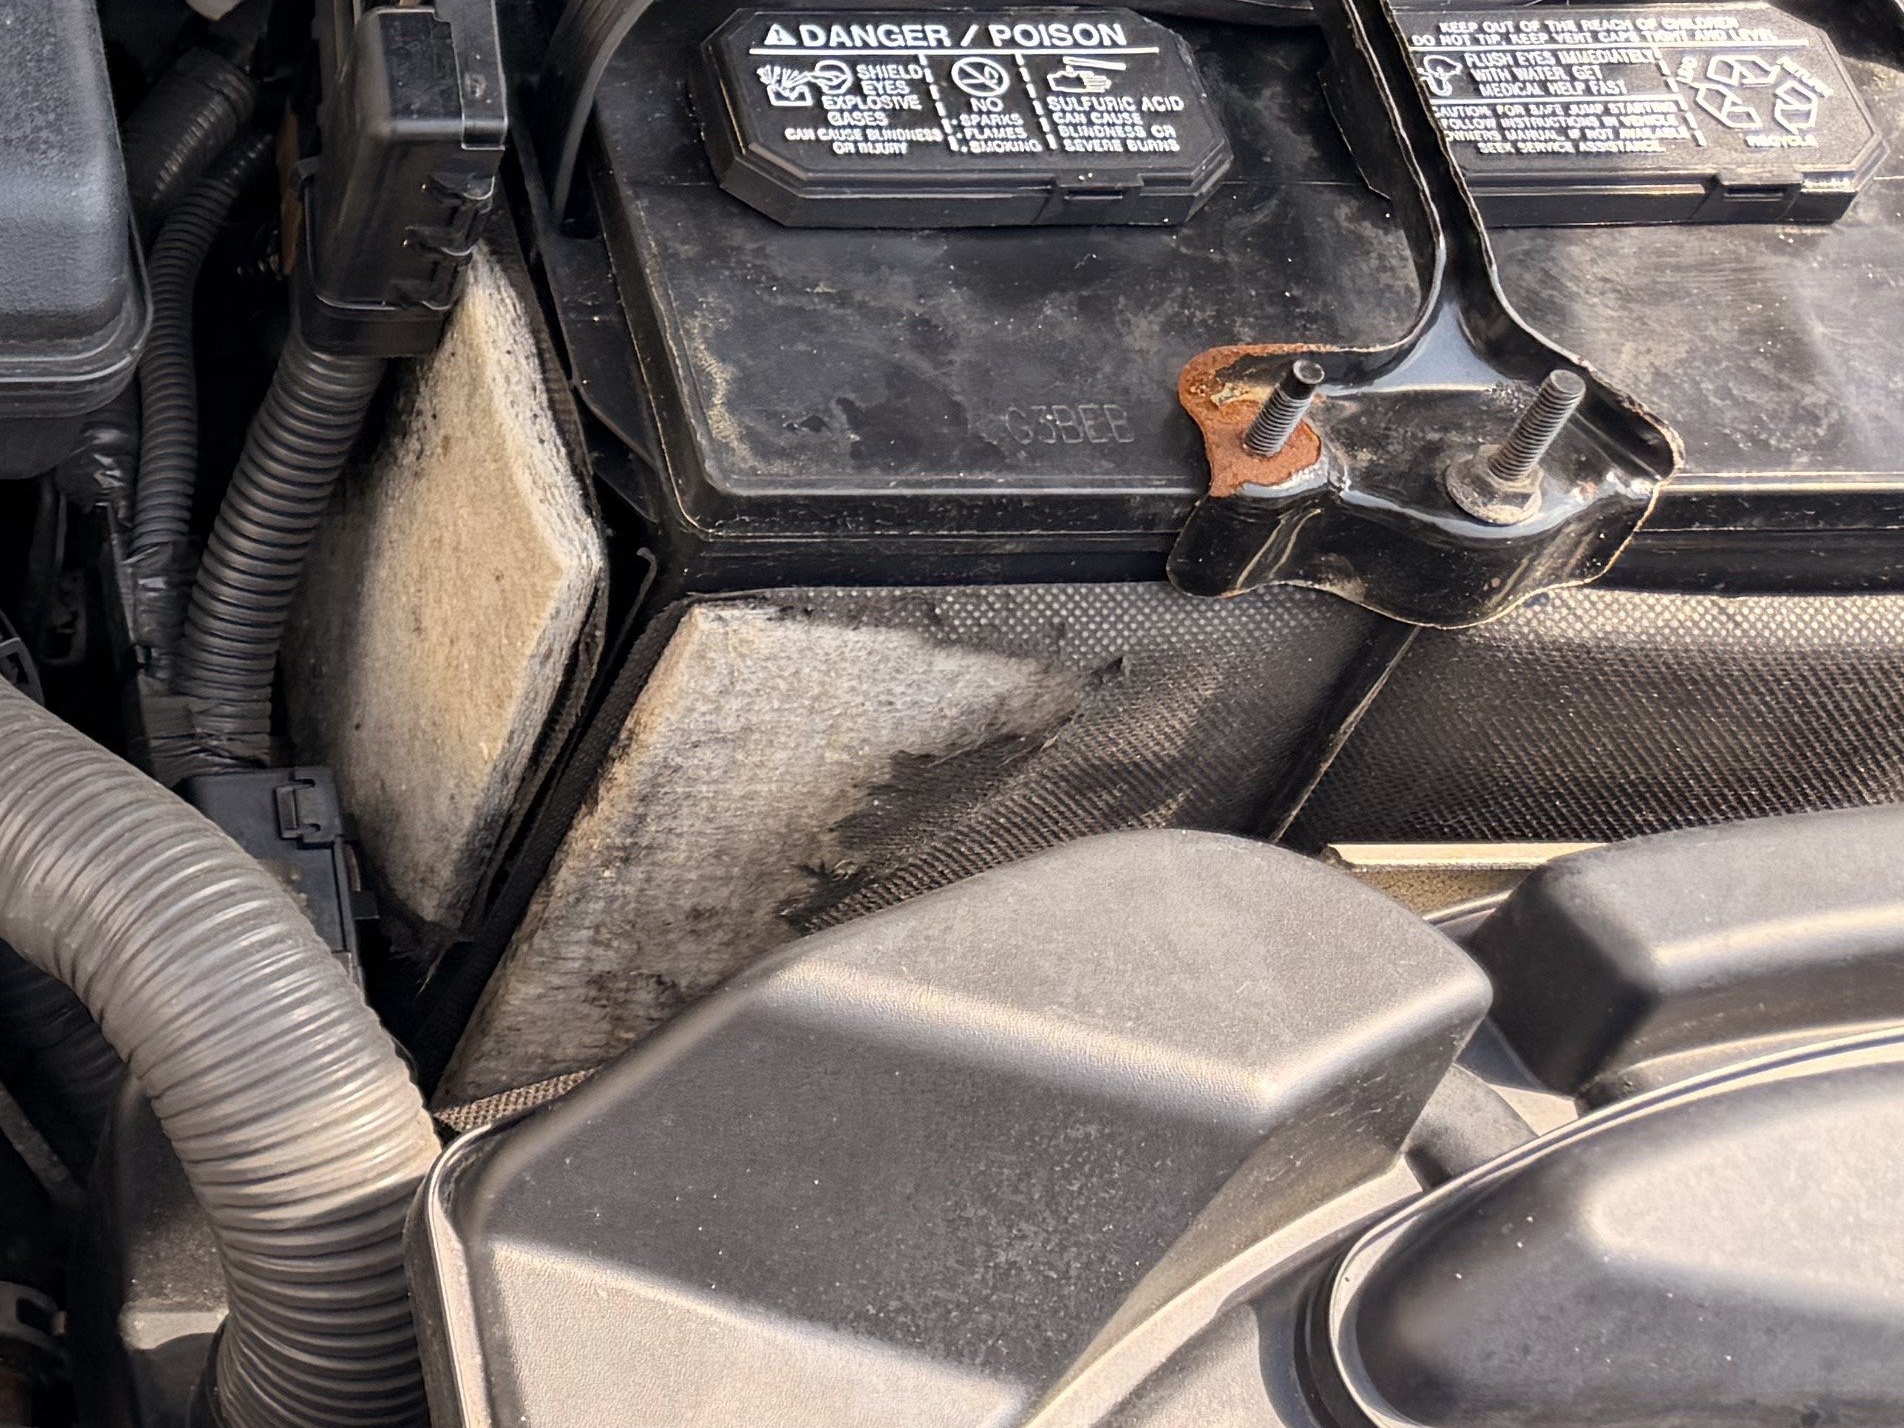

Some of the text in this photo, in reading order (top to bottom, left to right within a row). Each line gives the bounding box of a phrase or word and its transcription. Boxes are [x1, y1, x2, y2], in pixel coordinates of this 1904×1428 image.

[1439, 21, 1478, 35] KEEP
[1483, 21, 1516, 34] OUT
[1519, 20, 1541, 33] OF
[1544, 20, 1578, 33] THE
[1580, 19, 1633, 33] REACH
[1636, 18, 1658, 31] OF
[798, 22, 1128, 48] DANGER / POISON
[1412, 34, 1436, 47] DO
[1441, 33, 1472, 46] NOT
[1510, 33, 1550, 46] KEEP
[1557, 32, 1596, 45] VENT
[1597, 31, 1639, 44] CAPS
[1694, 29, 1729, 42] AND
[1464, 47, 1656, 68] FLUSH EYES IMMEDIATELY
[856, 63, 923, 80] SHIELD
[1471, 67, 1513, 82] WITH
[1572, 64, 1603, 80] GET
[862, 80, 910, 96] EYES
[1479, 79, 1628, 97] MEDICAL HELP FAST
[821, 95, 923, 111] EXPLOSIVE
[970, 97, 1005, 113] NO
[1047, 96, 1185, 112] SULFURIC ACID
[1496, 104, 1526, 117] FOR
[1529, 103, 1564, 116] SAFE
[1568, 102, 1605, 115] JUMP
[1607, 100, 1679, 114] STARTING
[827, 111, 889, 127] GASES
[958, 113, 1024, 127] SPARKS
[1052, 112, 1144, 126] CAN CAUSE
[1441, 117, 1497, 130] FOLLOW
[1500, 116, 1604, 129] INSTRUCTIONS
[1622, 113, 1679, 127] VEHICLE
[784, 128, 943, 142] CAN CAUSE BLINDNESS
[964, 126, 1028, 140] FLAMES
[1058, 125, 1177, 139] BLINDNESS OR
[1567, 128, 1582, 140] IF
[1585, 127, 1615, 140] NOT
[832, 141, 856, 155] OR
[969, 139, 1043, 154] SMOKING
[1063, 138, 1182, 153] SEVERE BURNS
[1478, 142, 1515, 154] SEEK
[1517, 141, 1576, 154] SERVICE
